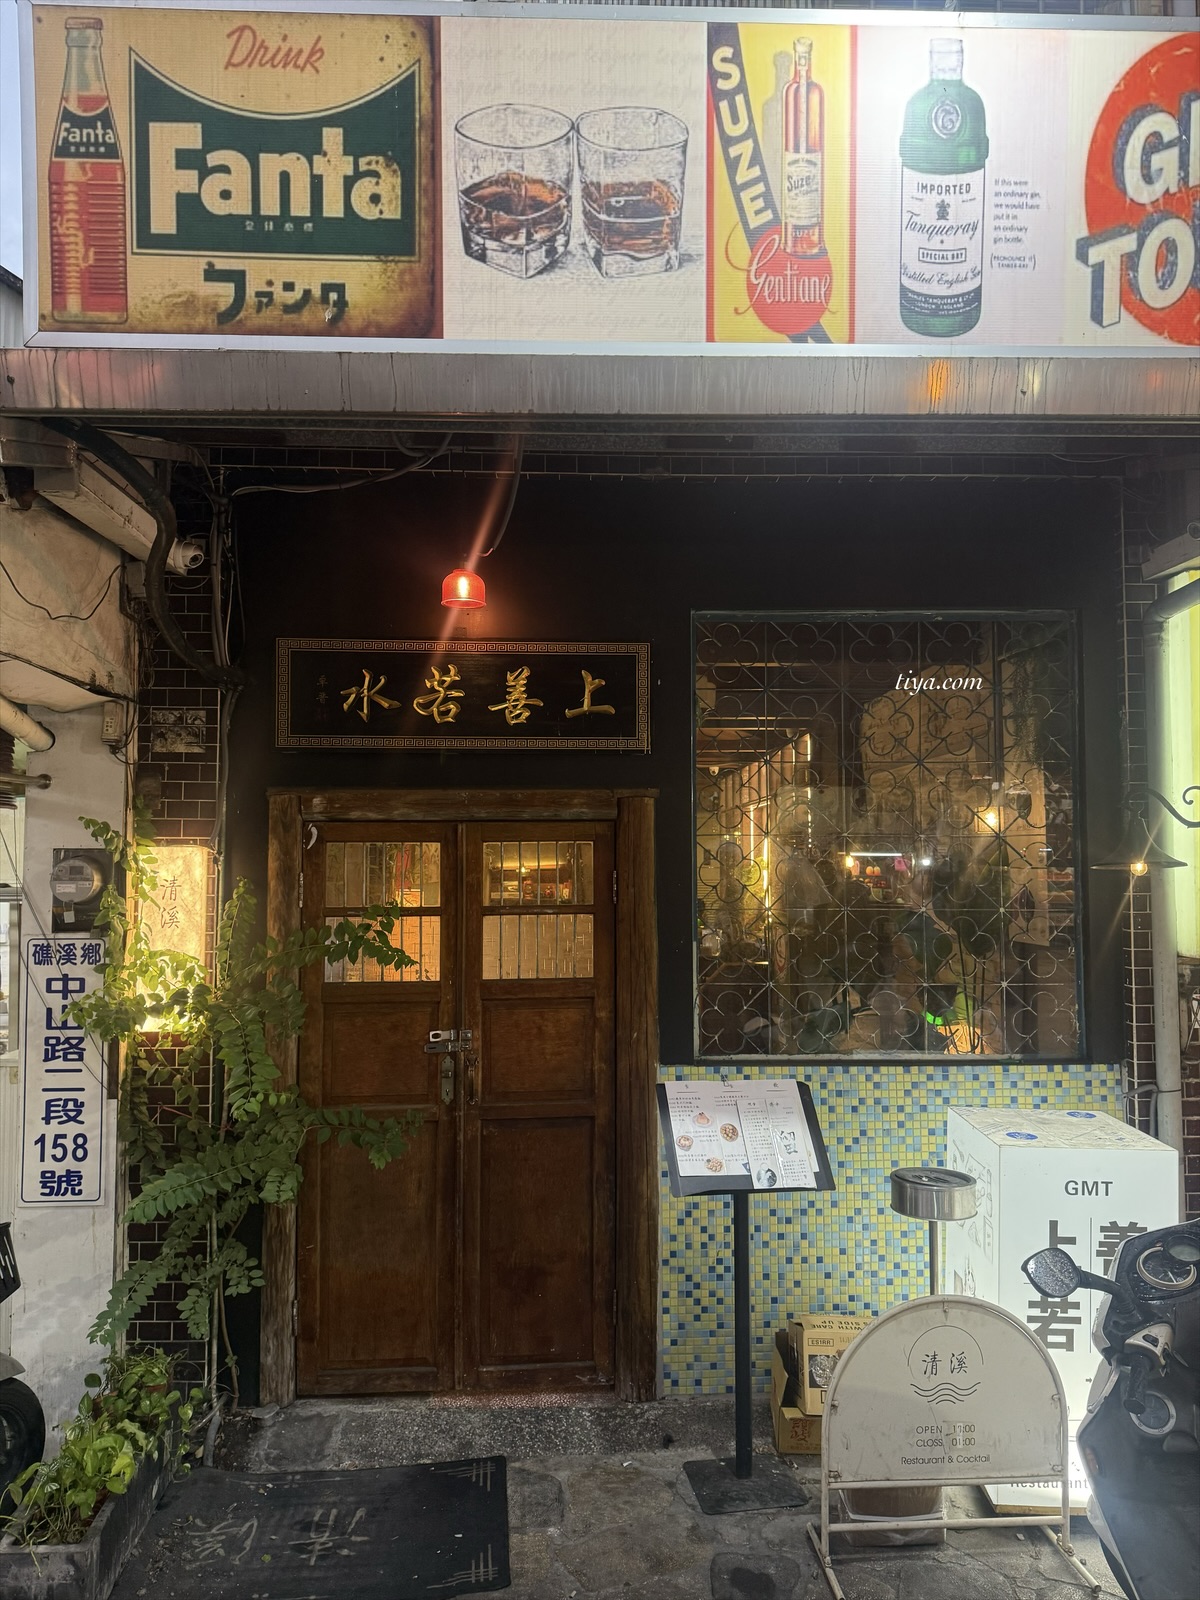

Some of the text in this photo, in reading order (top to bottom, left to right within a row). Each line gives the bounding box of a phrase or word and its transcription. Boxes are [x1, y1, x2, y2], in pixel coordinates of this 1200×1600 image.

[225, 24, 325, 74] Drink
[58, 120, 115, 146] Fanta
[711, 45, 773, 230] SUZE
[149, 122, 401, 234] Fanta
[917, 182, 971, 195] IMPORTED
[1003, 190, 1029, 198] ordinary
[1005, 201, 1024, 209] would
[905, 210, 979, 241] Tanqueray
[921, 250, 963, 260] SPECIAL DRY
[738, 228, 834, 310] Gentiane
[937, 272, 968, 288] English
[204, 268, 349, 326] ファンタ
[159, 874, 182, 931] 清溪
[32, 943, 101, 967] 礁溪鄉
[1064, 1180, 1113, 1197] GMT
[922, 1350, 968, 1376] 清溪
[916, 1425, 943, 1434] OPEN
[916, 1439, 943, 1447] CLOSS
[901, 1455, 991, 1465] Restaurant & Cocktail
[1010, 1477, 1089, 1488] estauant
